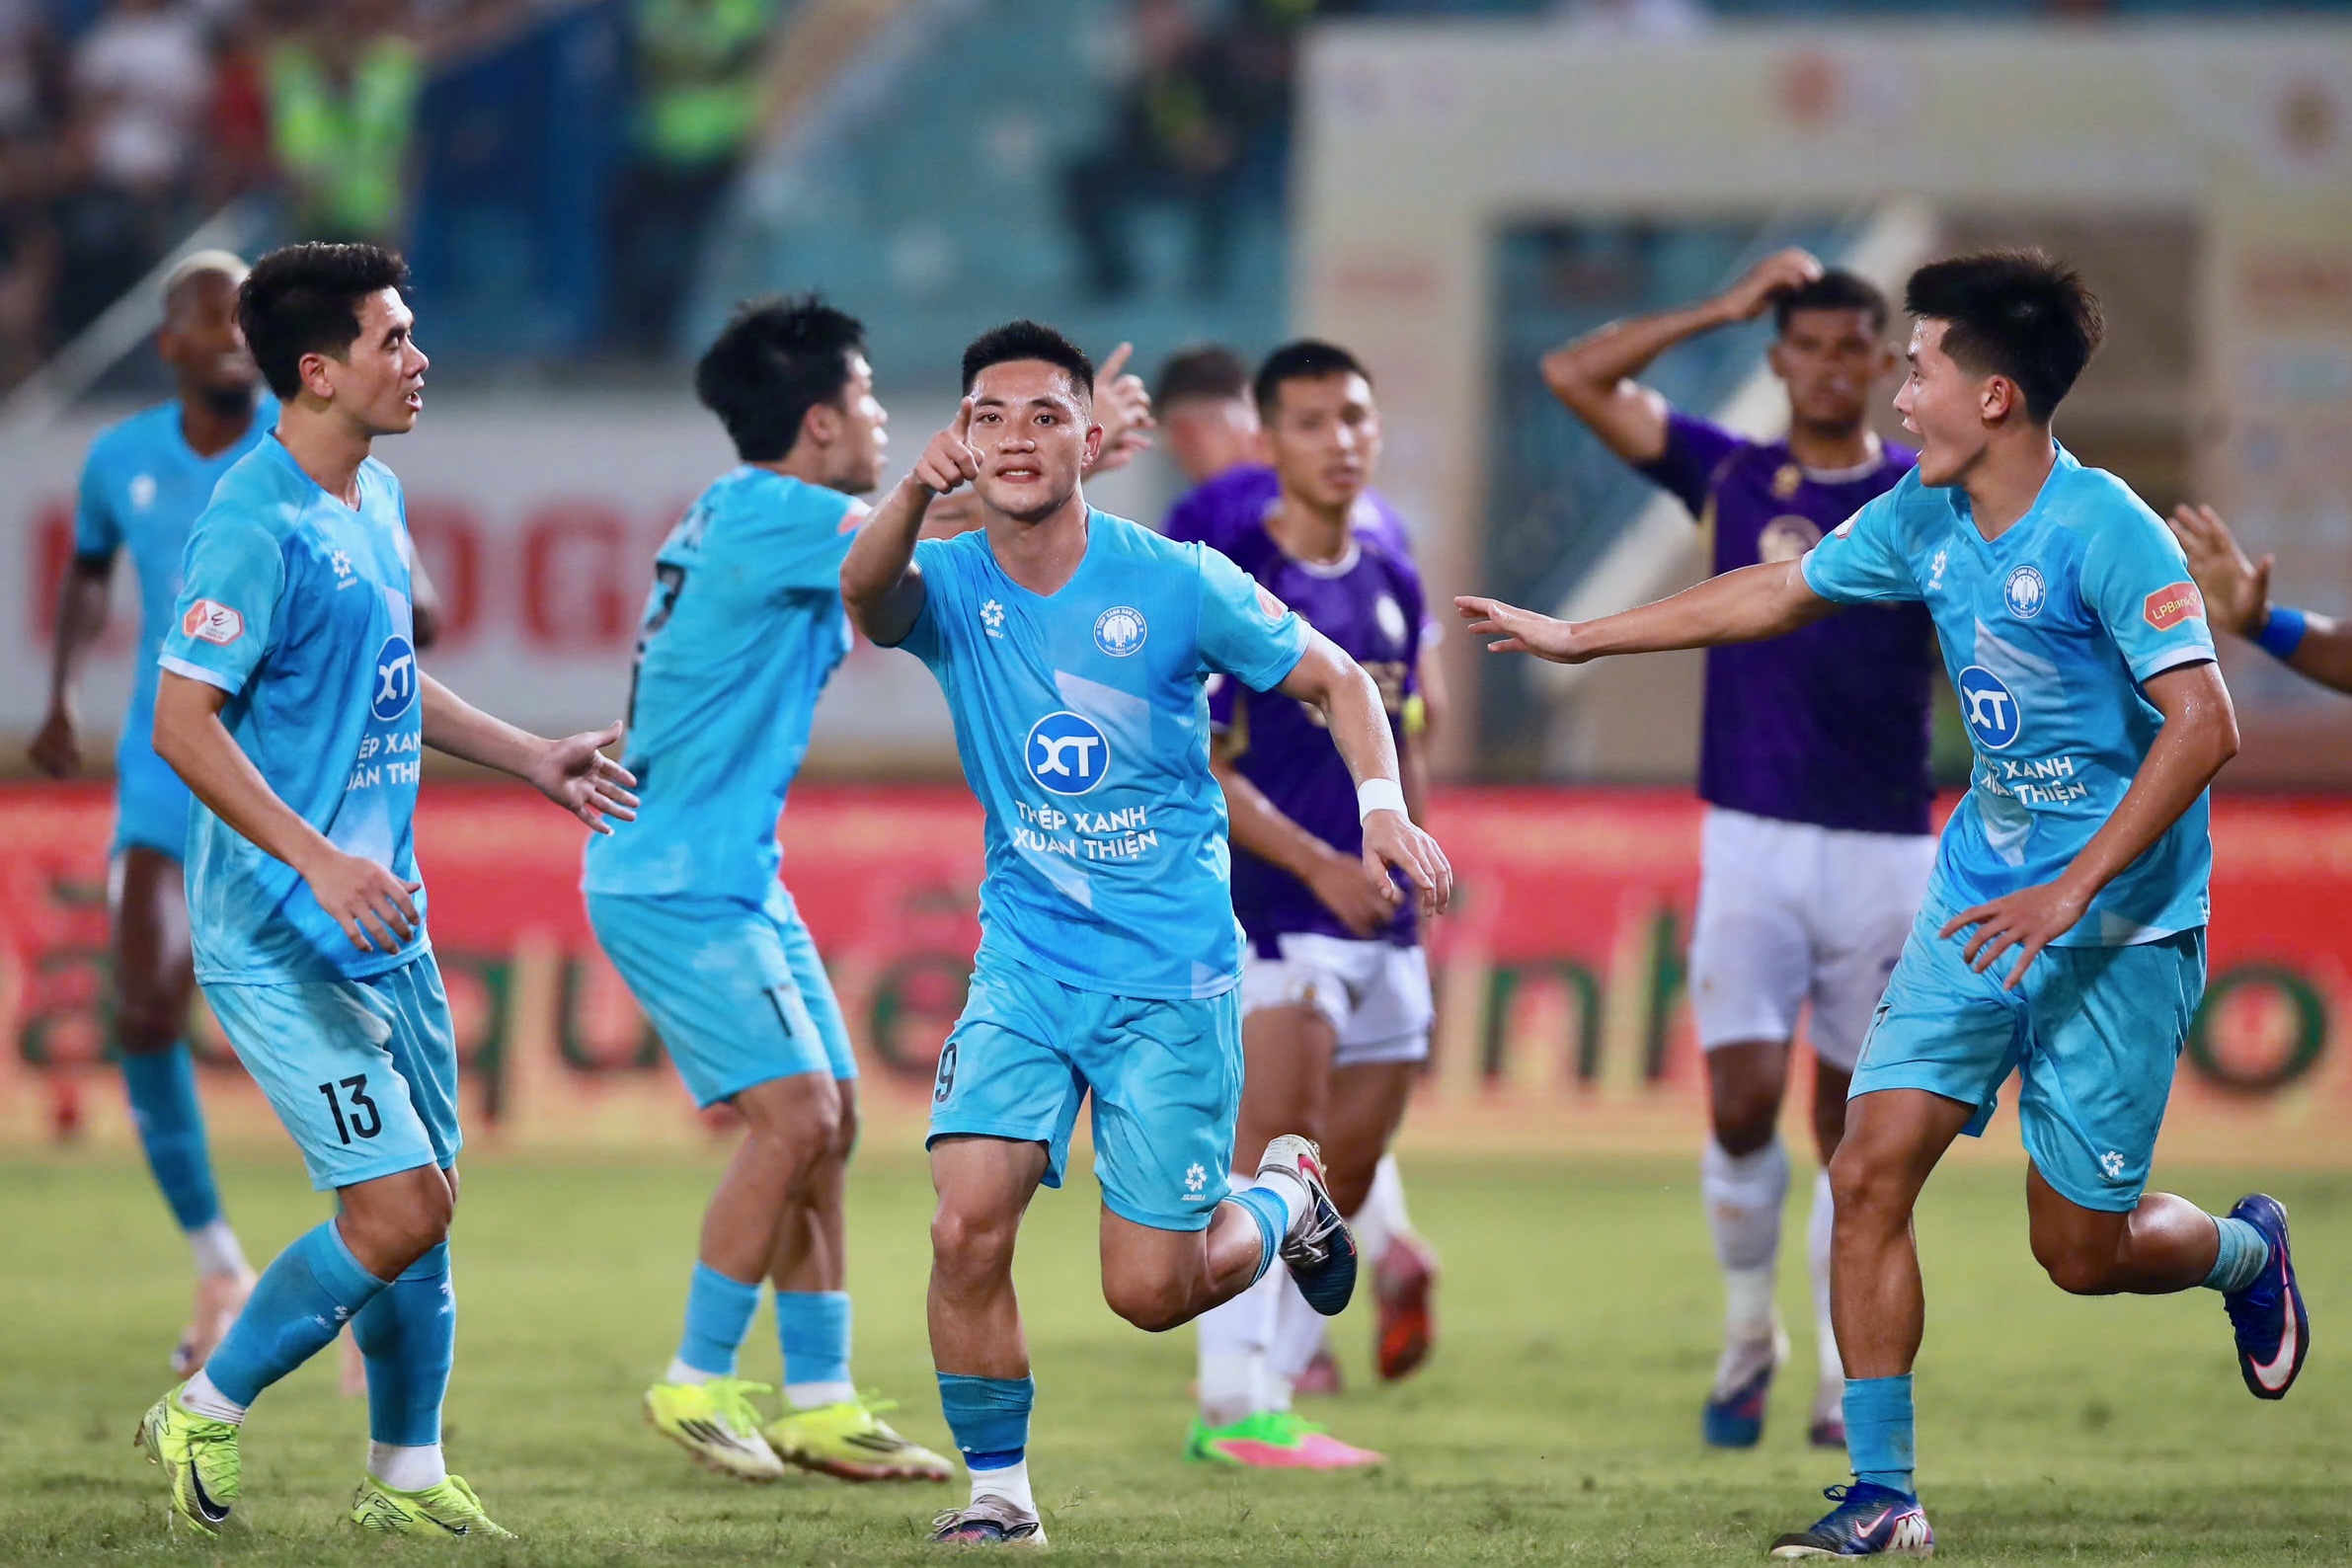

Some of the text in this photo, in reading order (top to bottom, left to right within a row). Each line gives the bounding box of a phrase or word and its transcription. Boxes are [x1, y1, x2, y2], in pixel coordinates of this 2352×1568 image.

[2152, 594, 2192, 620] LPBank
[1962, 684, 2008, 731] XT
[383, 728, 422, 755] XAN
[1037, 734, 1099, 777] XT
[2001, 755, 2074, 780] XANH
[2013, 779, 2088, 806] THIỆN
[1015, 799, 1147, 833] THÉP XANH
[1083, 829, 1159, 860] THIỆN
[934, 1042, 958, 1104] 9
[318, 1072, 383, 1145] 13
